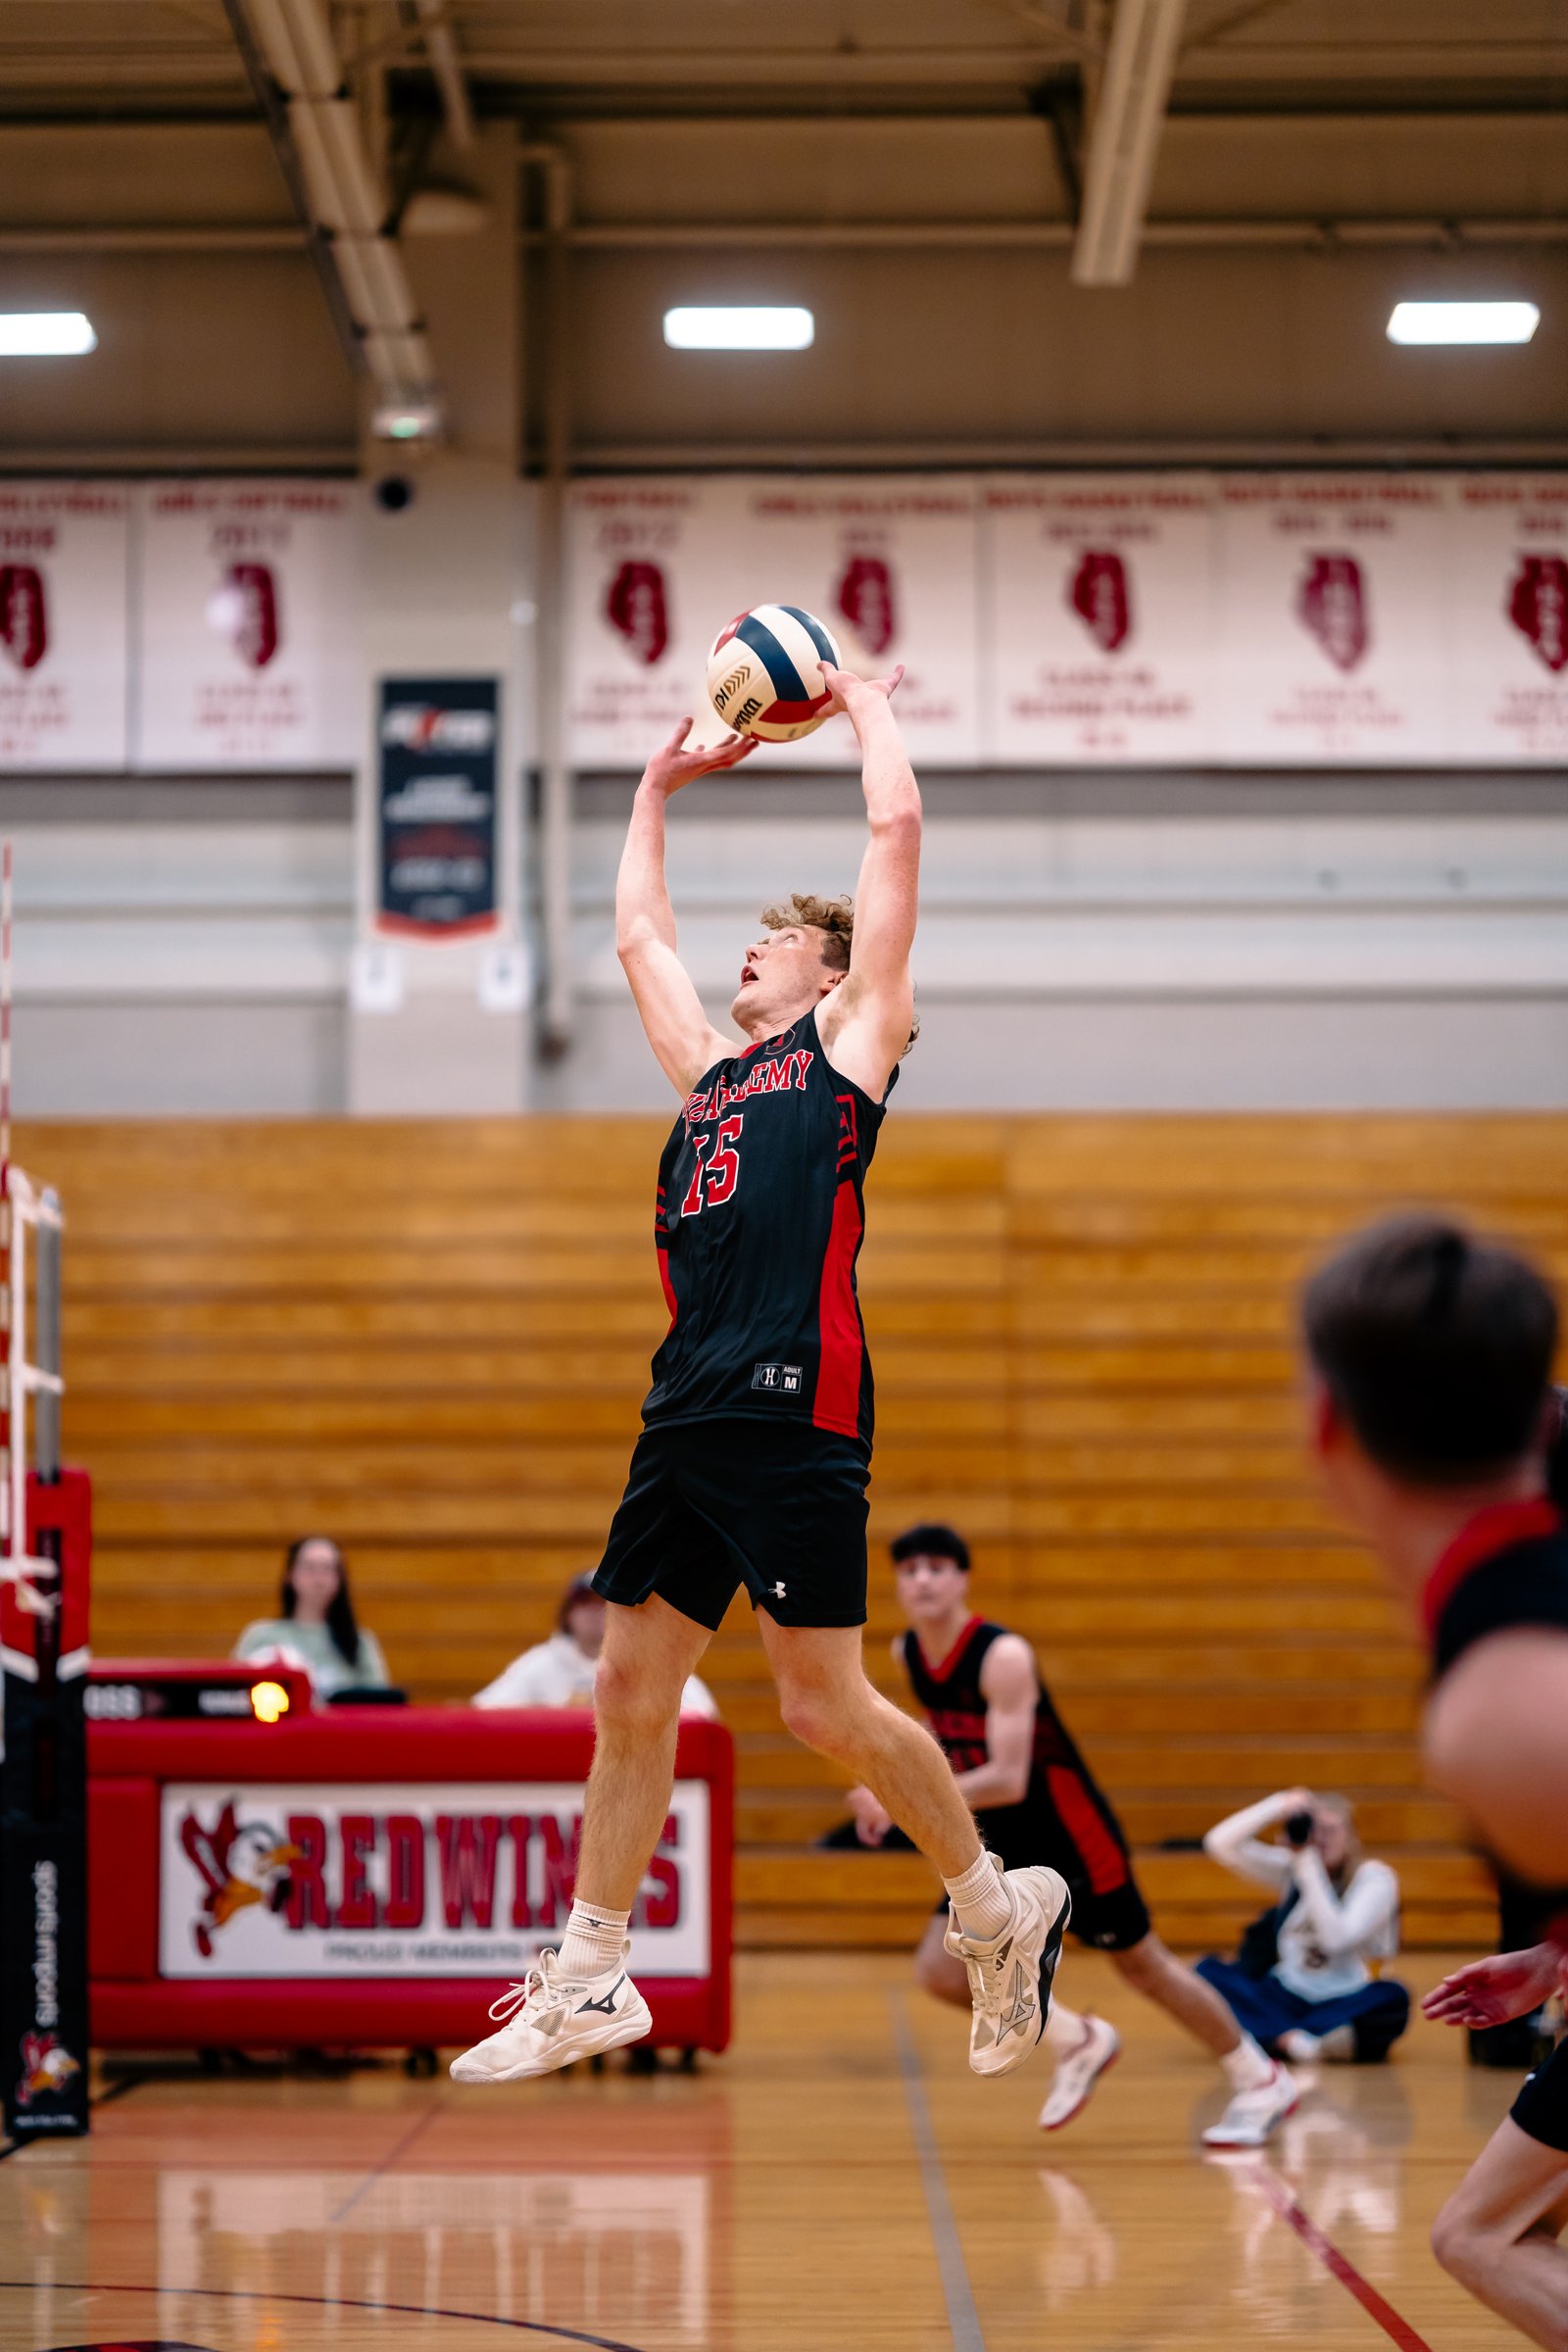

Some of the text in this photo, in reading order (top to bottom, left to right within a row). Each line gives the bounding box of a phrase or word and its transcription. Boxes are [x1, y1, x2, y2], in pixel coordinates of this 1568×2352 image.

[681, 1113, 744, 1218] 15
[784, 1376, 797, 1390] M
[288, 1815, 680, 1930] REDWINS
